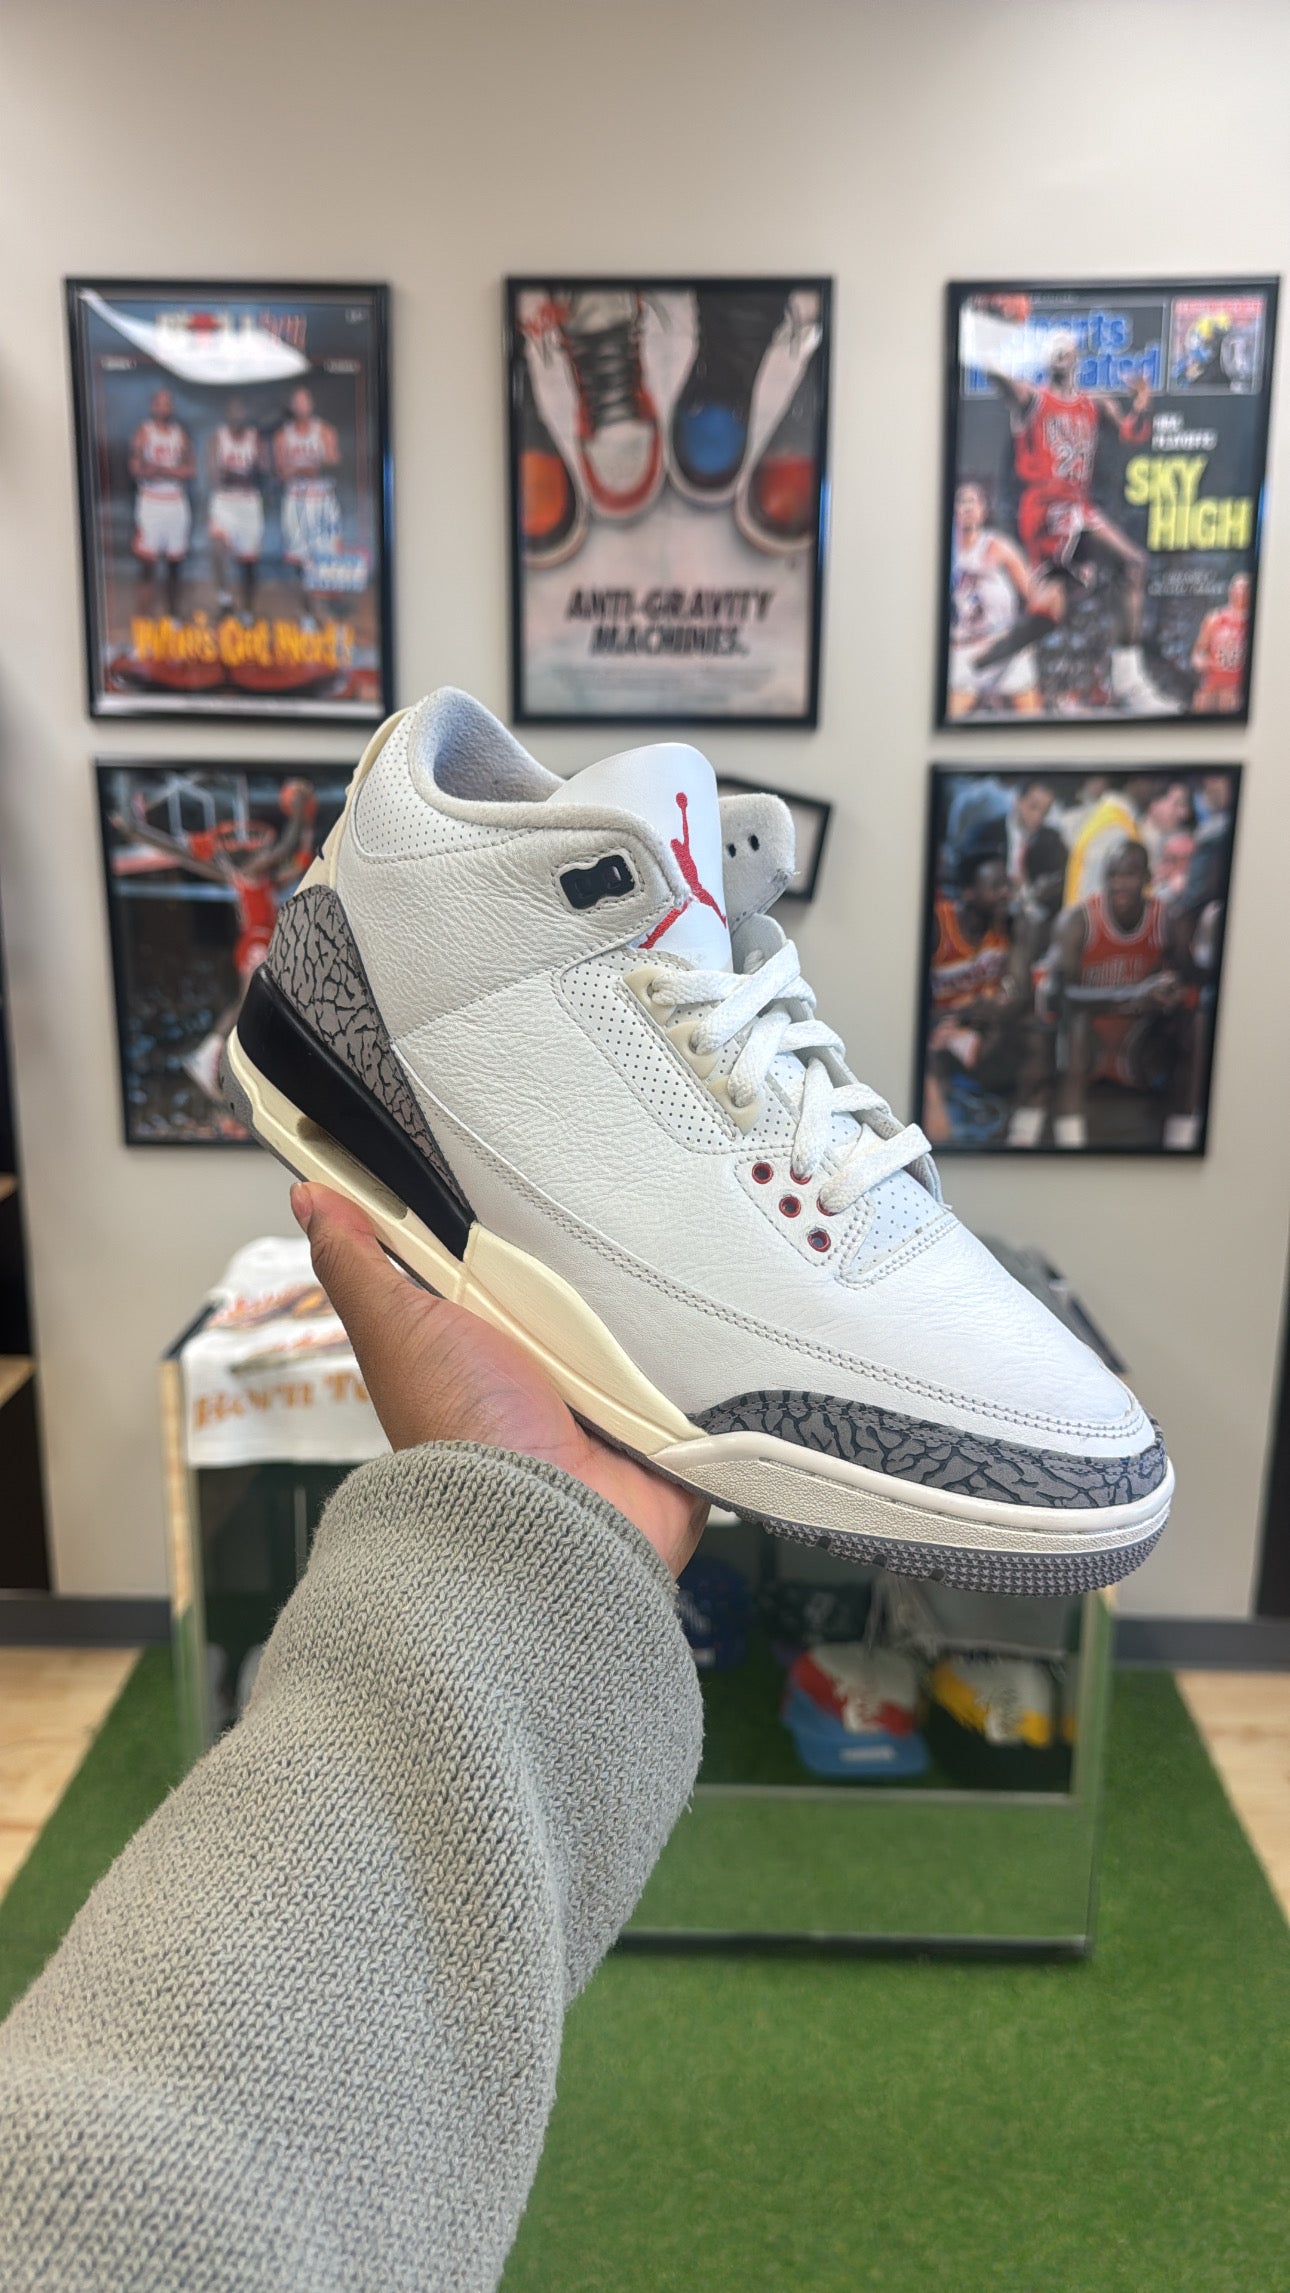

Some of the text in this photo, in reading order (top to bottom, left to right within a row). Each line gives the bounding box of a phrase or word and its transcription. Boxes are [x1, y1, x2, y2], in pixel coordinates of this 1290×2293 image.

[1124, 455, 1208, 506] SKY
[1146, 497, 1252, 551] HIGH
[567, 586, 774, 620] ANTI-GRAVITY
